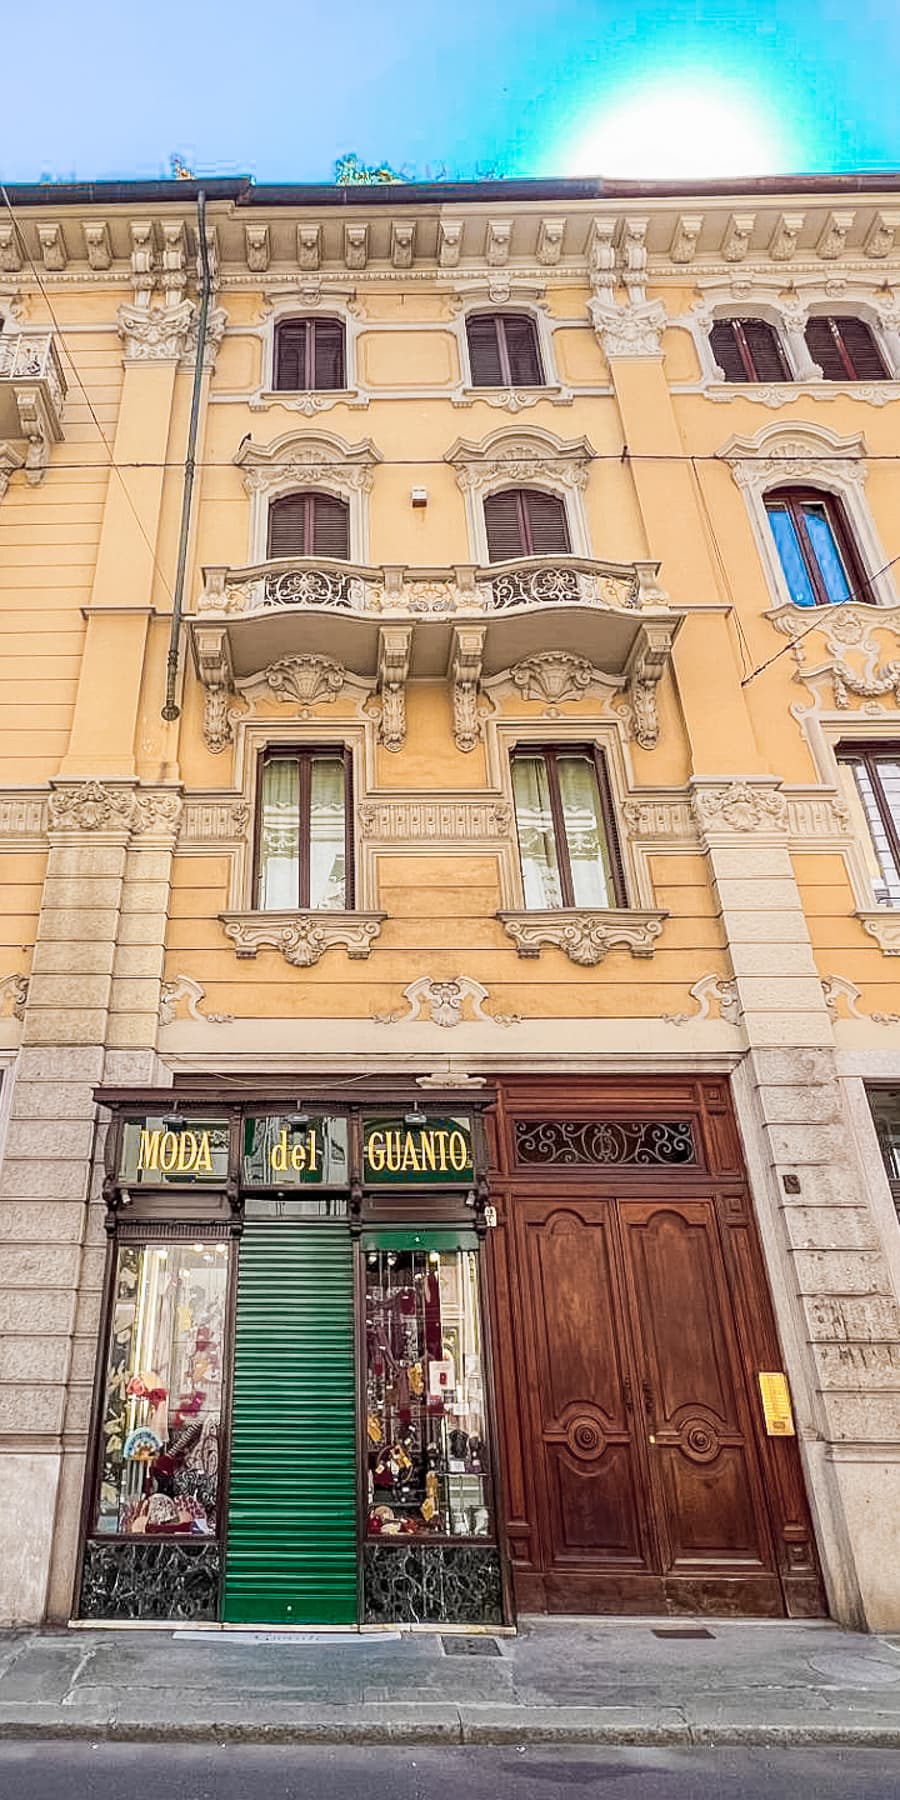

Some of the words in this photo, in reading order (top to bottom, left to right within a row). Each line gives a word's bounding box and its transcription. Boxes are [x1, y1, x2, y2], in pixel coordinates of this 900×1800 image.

[137, 1130, 213, 1171] MODA
[271, 1129, 317, 1171] del
[368, 1131, 467, 1171] GUANTO
